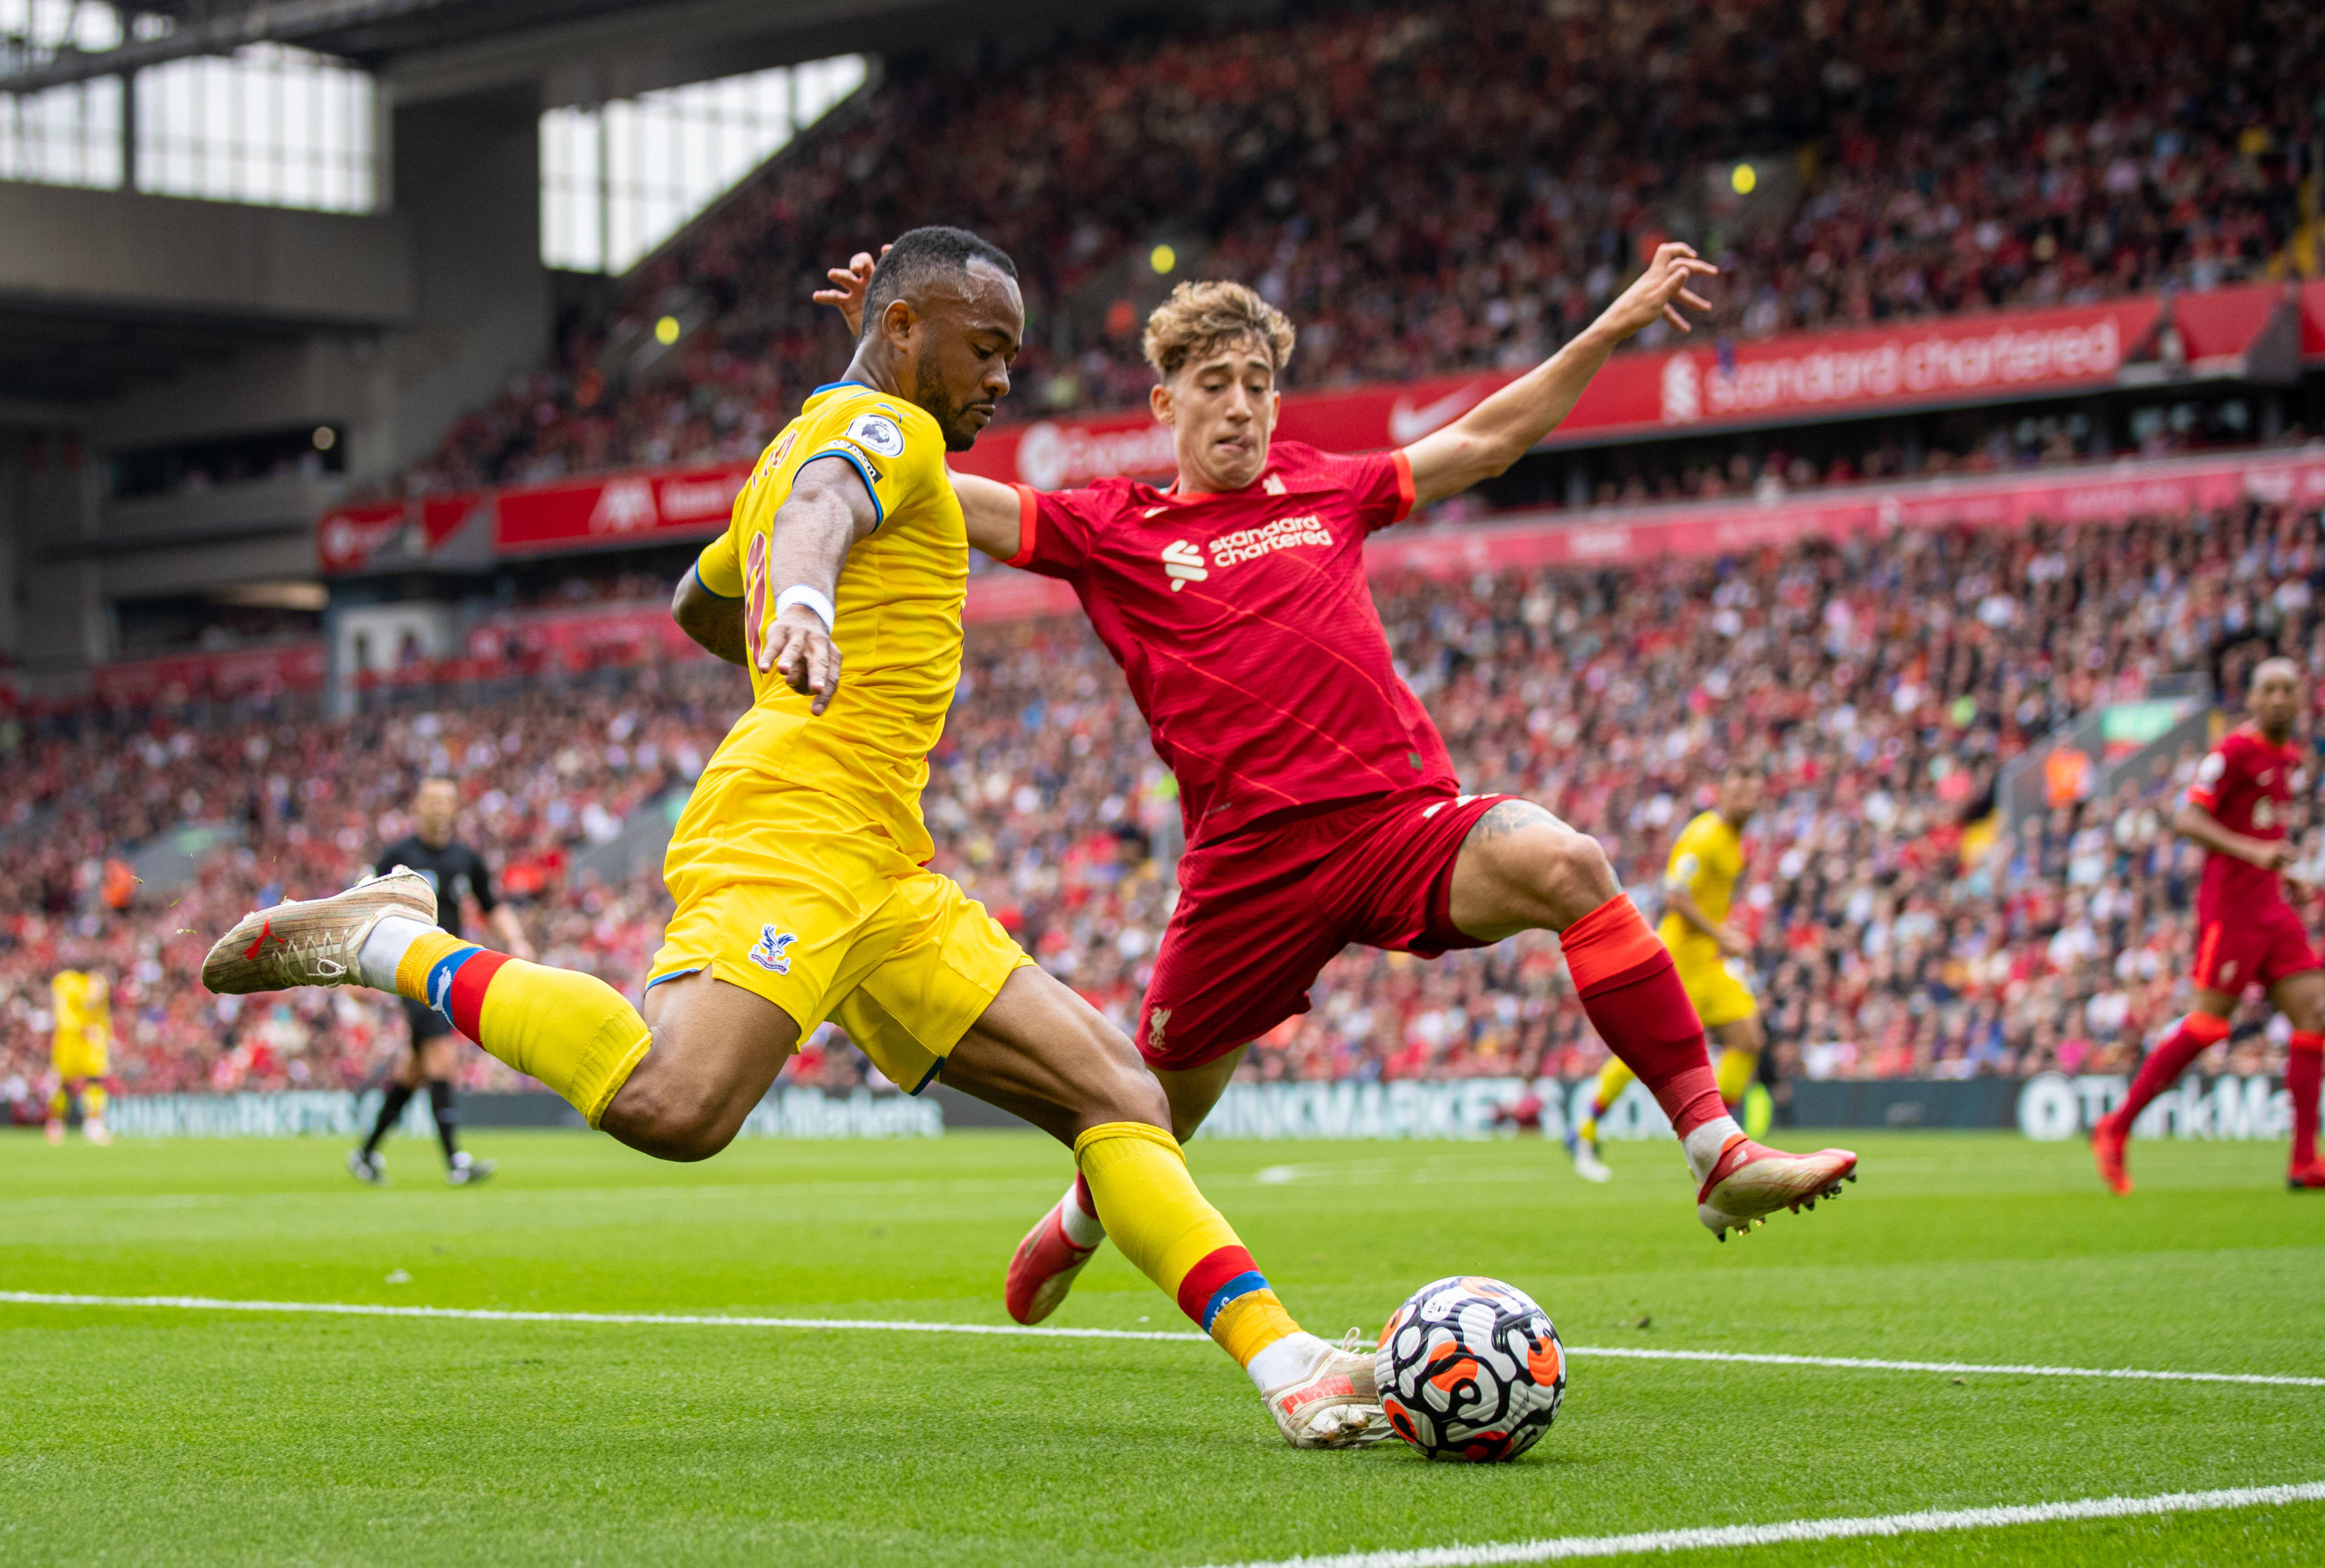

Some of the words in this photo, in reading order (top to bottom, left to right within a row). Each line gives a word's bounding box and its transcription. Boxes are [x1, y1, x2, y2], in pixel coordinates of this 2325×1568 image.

[1208, 515, 1321, 554] standard
[1214, 529, 1333, 567] chartered
[1281, 1374, 1355, 1416] PUMA
